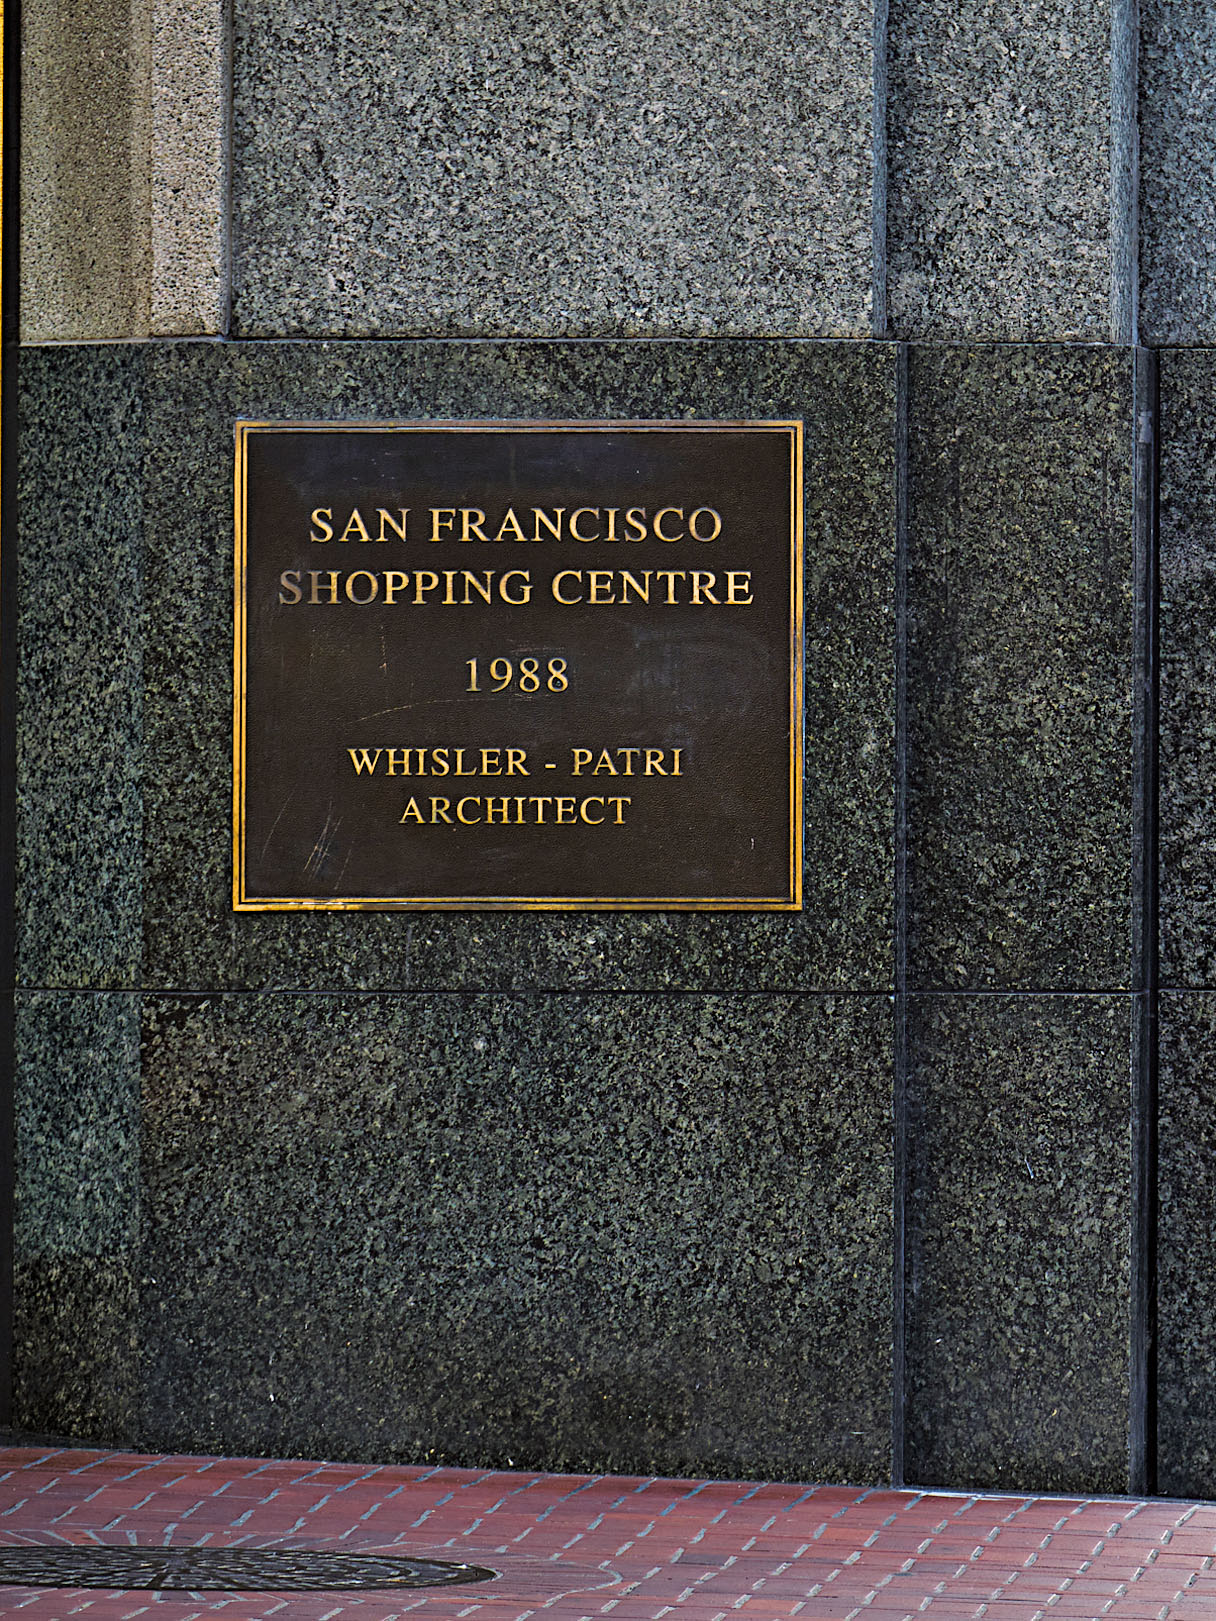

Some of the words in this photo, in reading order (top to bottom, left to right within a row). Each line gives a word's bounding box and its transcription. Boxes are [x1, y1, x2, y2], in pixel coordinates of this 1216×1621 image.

[309, 507, 412, 543] SAN
[428, 507, 723, 543] FRANCISCO
[278, 570, 533, 606] SHOPPING
[551, 570, 755, 606] CENTRE
[465, 657, 570, 693] 1988
[347, 748, 532, 777] WHISLER
[571, 748, 684, 777] PATRI
[399, 796, 632, 825] ARCHITECT
